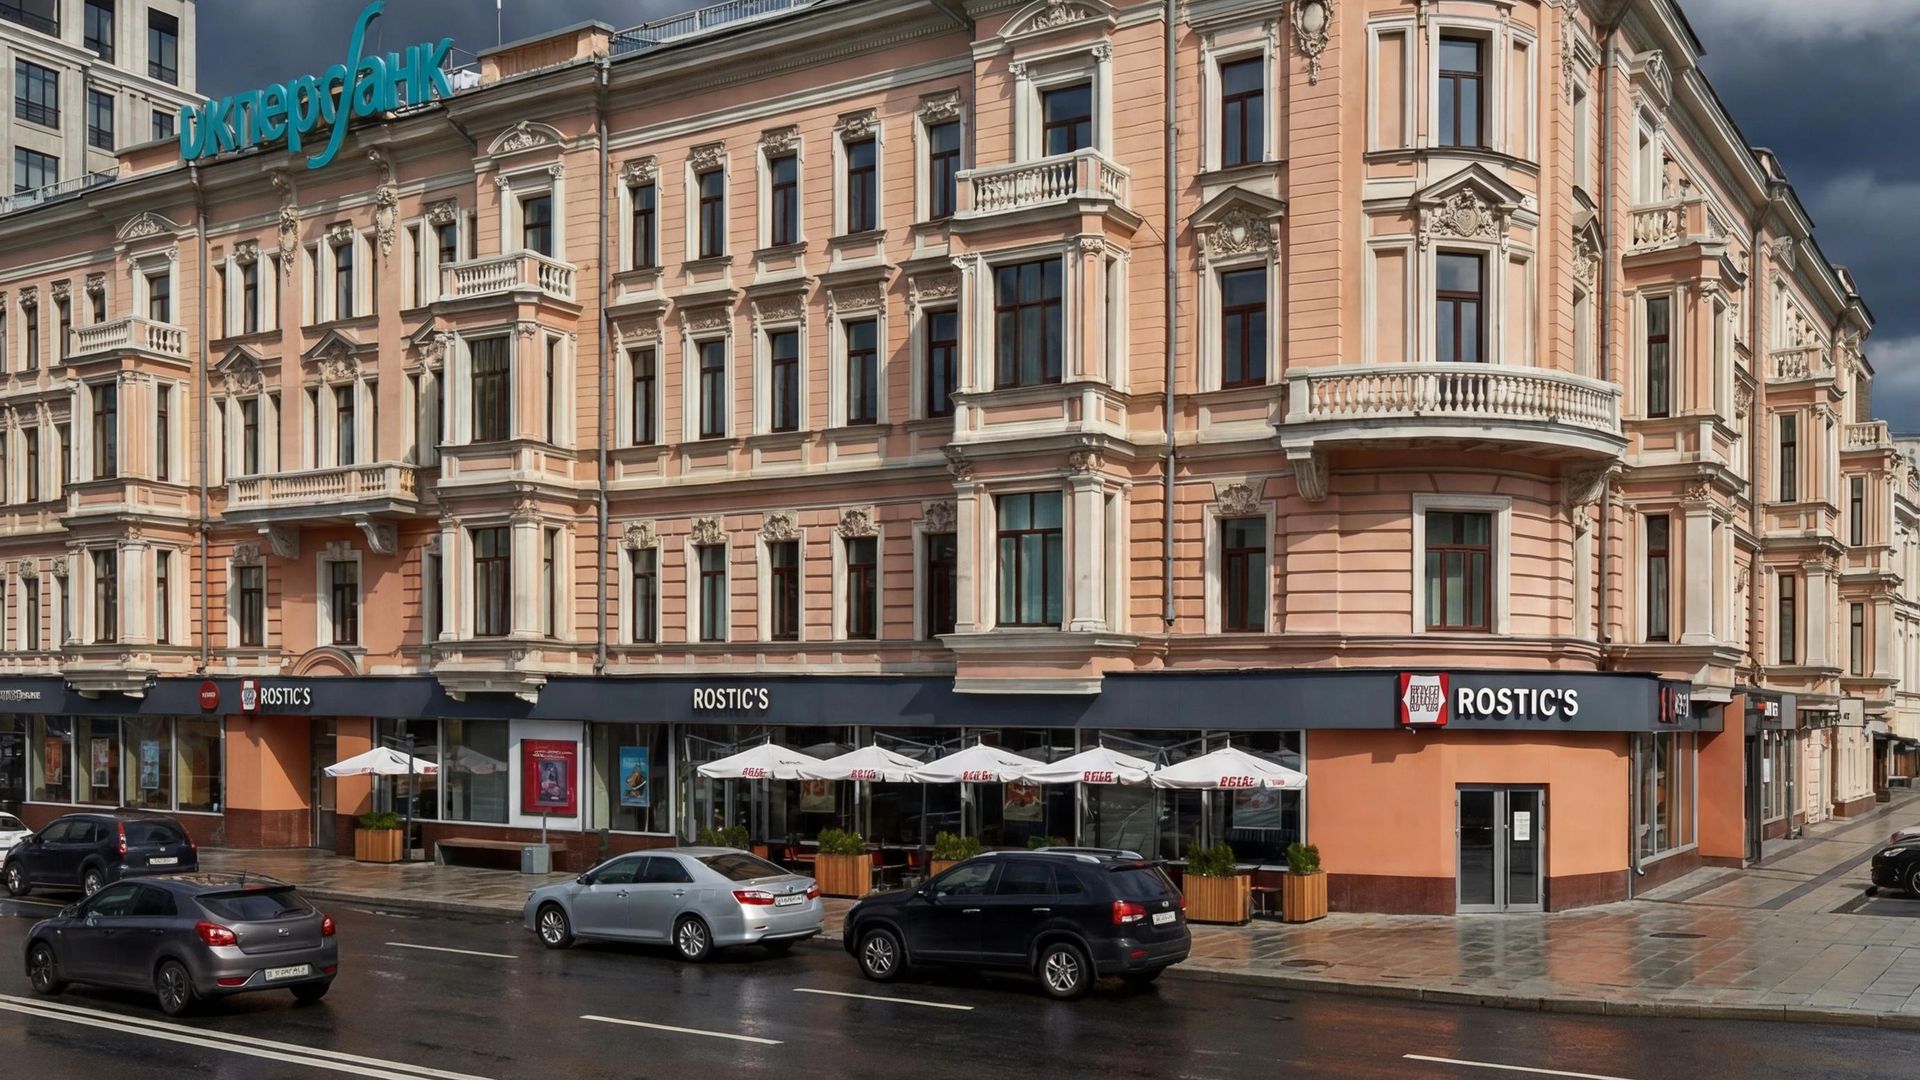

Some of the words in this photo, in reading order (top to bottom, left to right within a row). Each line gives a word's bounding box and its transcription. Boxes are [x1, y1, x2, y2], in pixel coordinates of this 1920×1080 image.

[260, 687, 311, 705] ROSTIC'S
[693, 688, 769, 710] ROSTIC'S
[1457, 687, 1580, 717] ROSTIC'S
